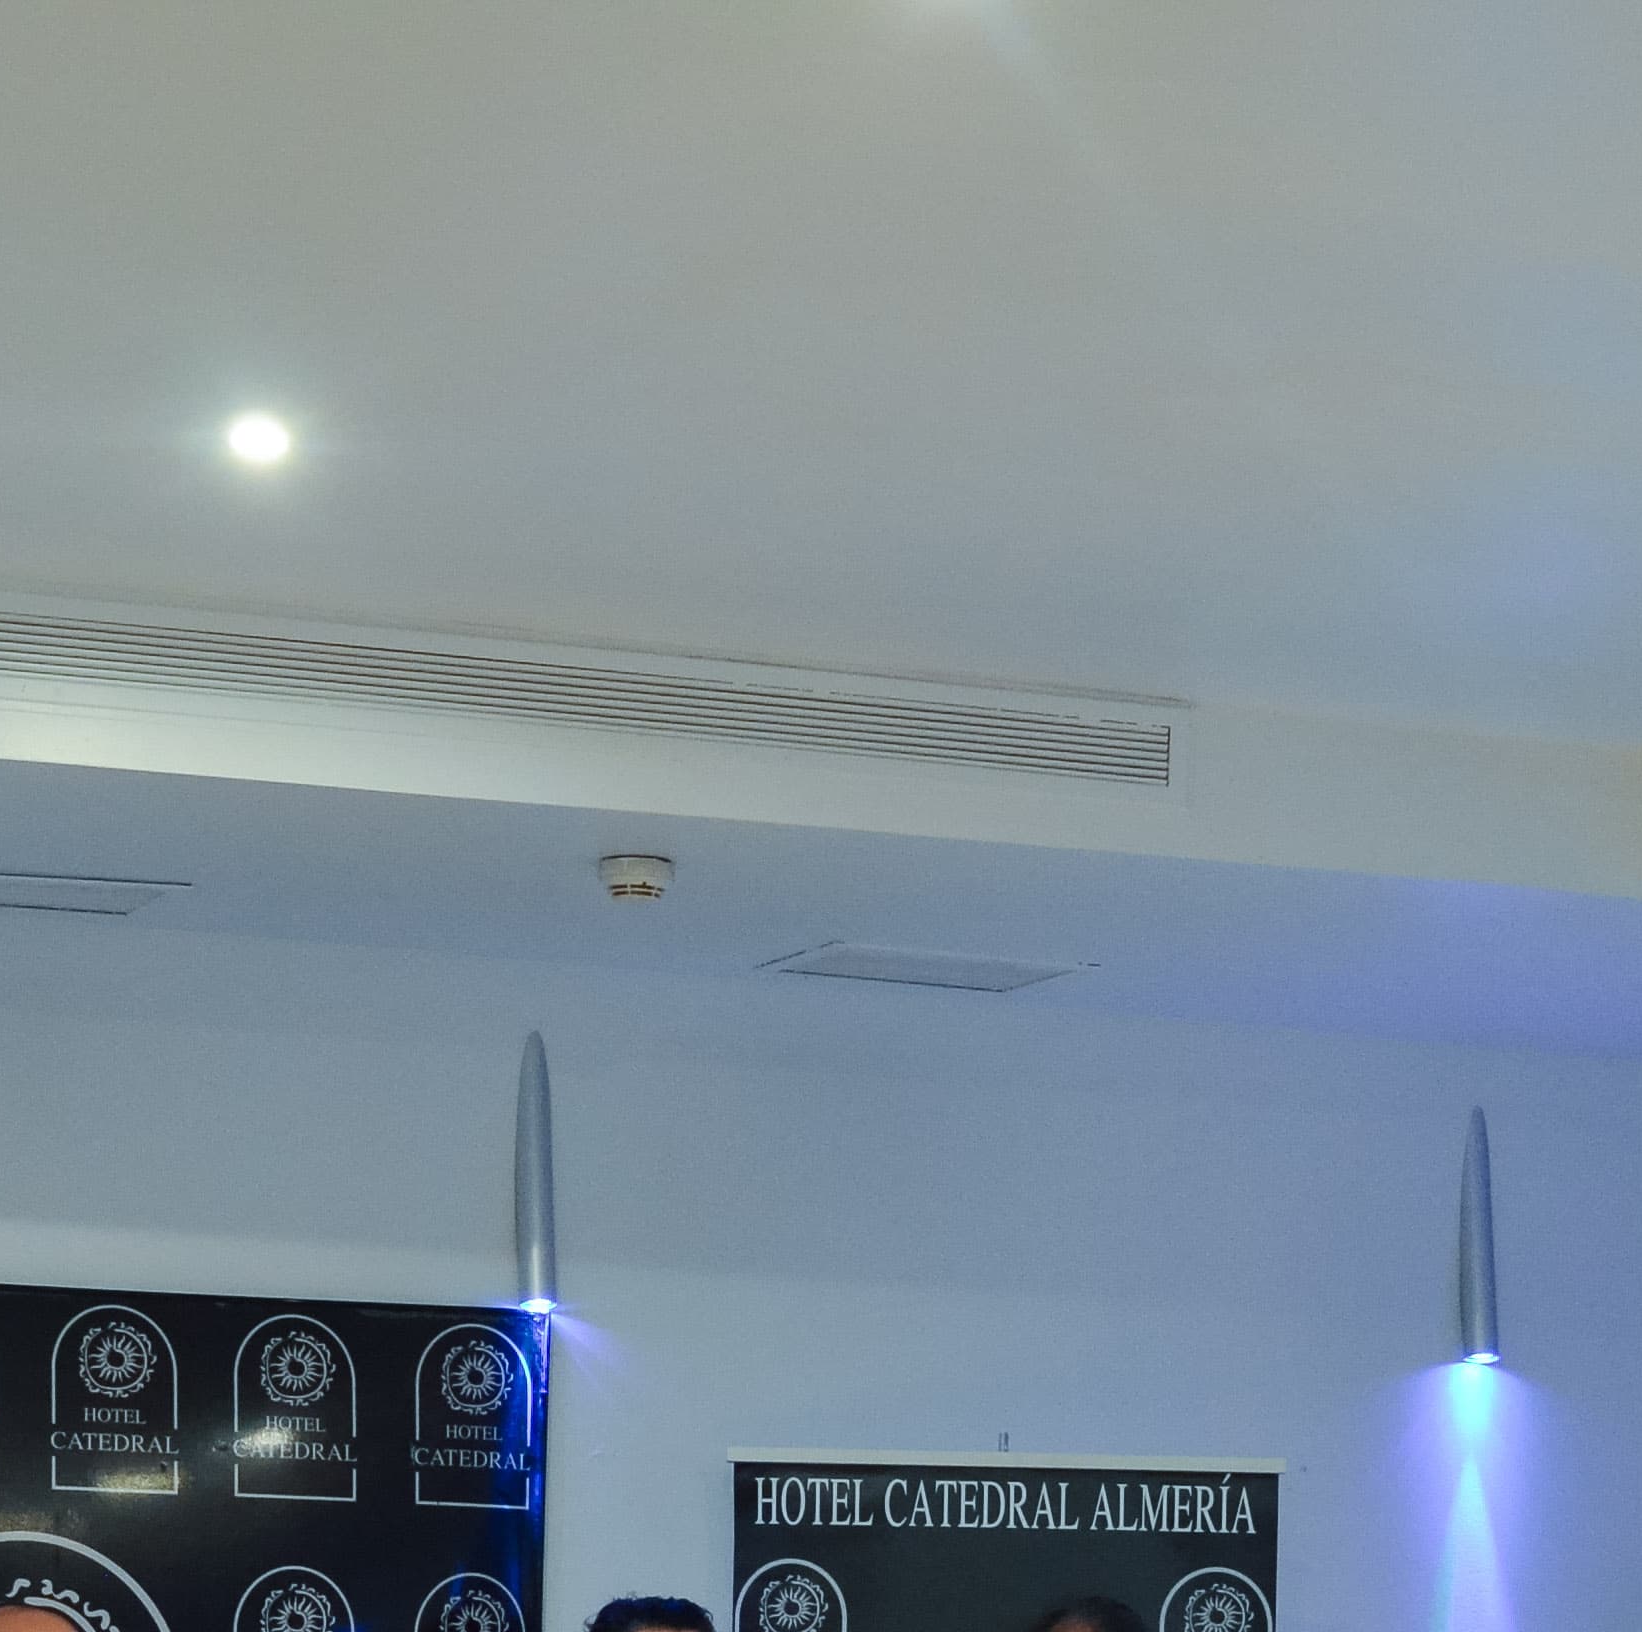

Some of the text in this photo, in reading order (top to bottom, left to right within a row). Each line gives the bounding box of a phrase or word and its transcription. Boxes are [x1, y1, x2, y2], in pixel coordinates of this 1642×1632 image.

[84, 1407, 147, 1425] HOTEL
[265, 1415, 326, 1433] HOTEL
[50, 1431, 179, 1455] CATEDRAL
[446, 1424, 504, 1441] HOTEL
[233, 1439, 357, 1463] CATEDRAL
[413, 1448, 531, 1472] CATEDRAL
[754, 1474, 1257, 1535] HOTEL CATEDRAL ALMERÍA
